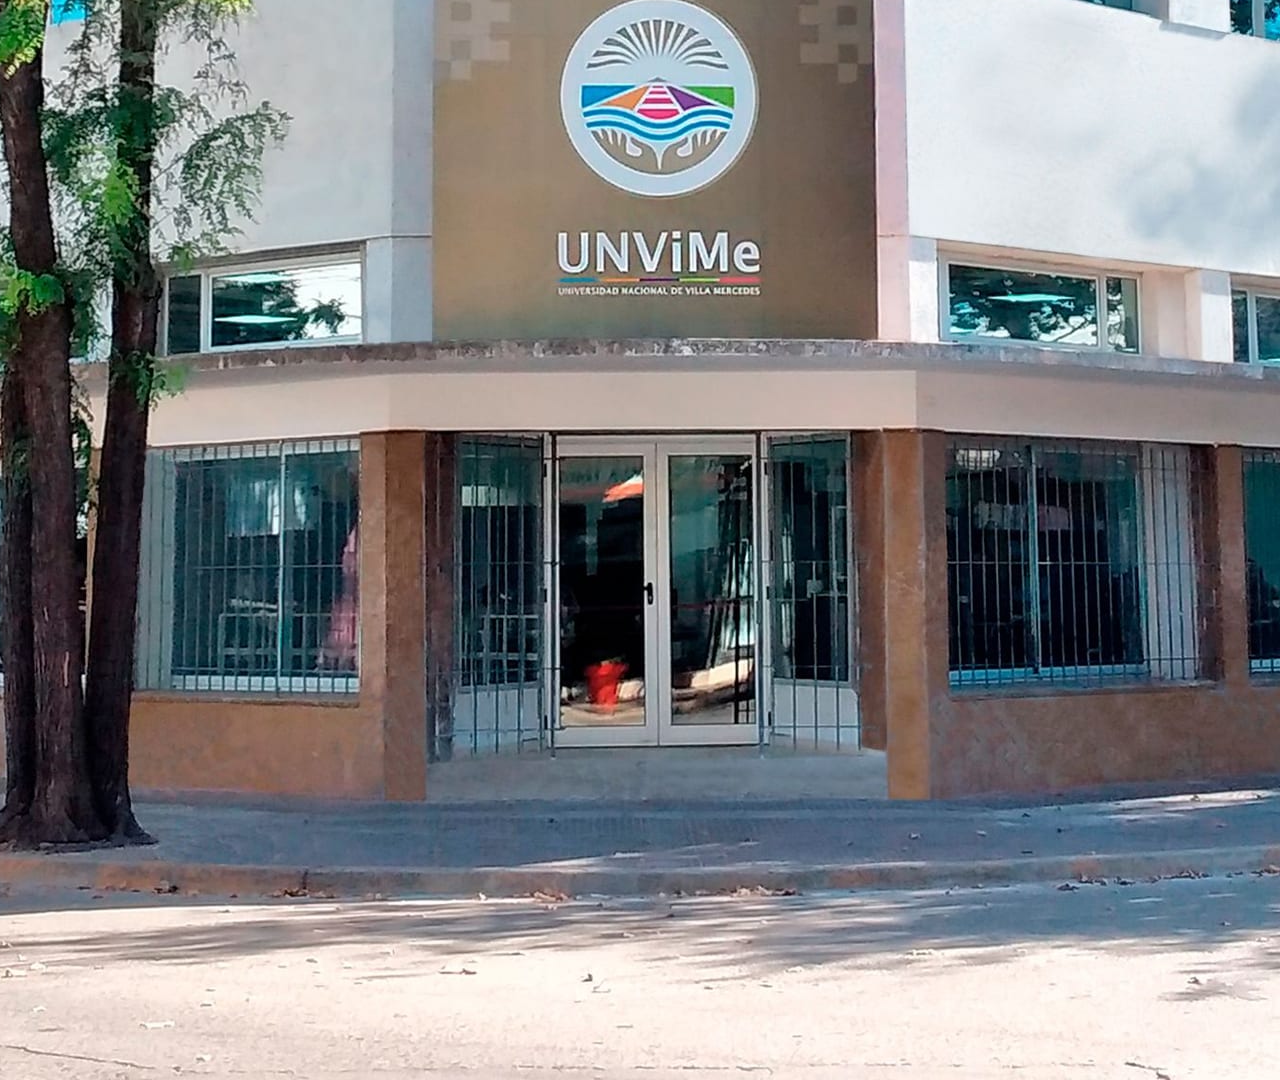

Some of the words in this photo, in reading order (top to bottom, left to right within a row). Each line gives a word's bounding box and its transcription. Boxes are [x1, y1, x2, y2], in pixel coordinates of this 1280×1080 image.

[557, 230, 761, 274] UNViMe
[558, 286, 619, 296] UNIVERSIDAD
[621, 286, 669, 296] NACIONAL
[671, 286, 684, 296] DE
[685, 286, 711, 296] VILLA
[712, 286, 761, 296] MERCEDES
